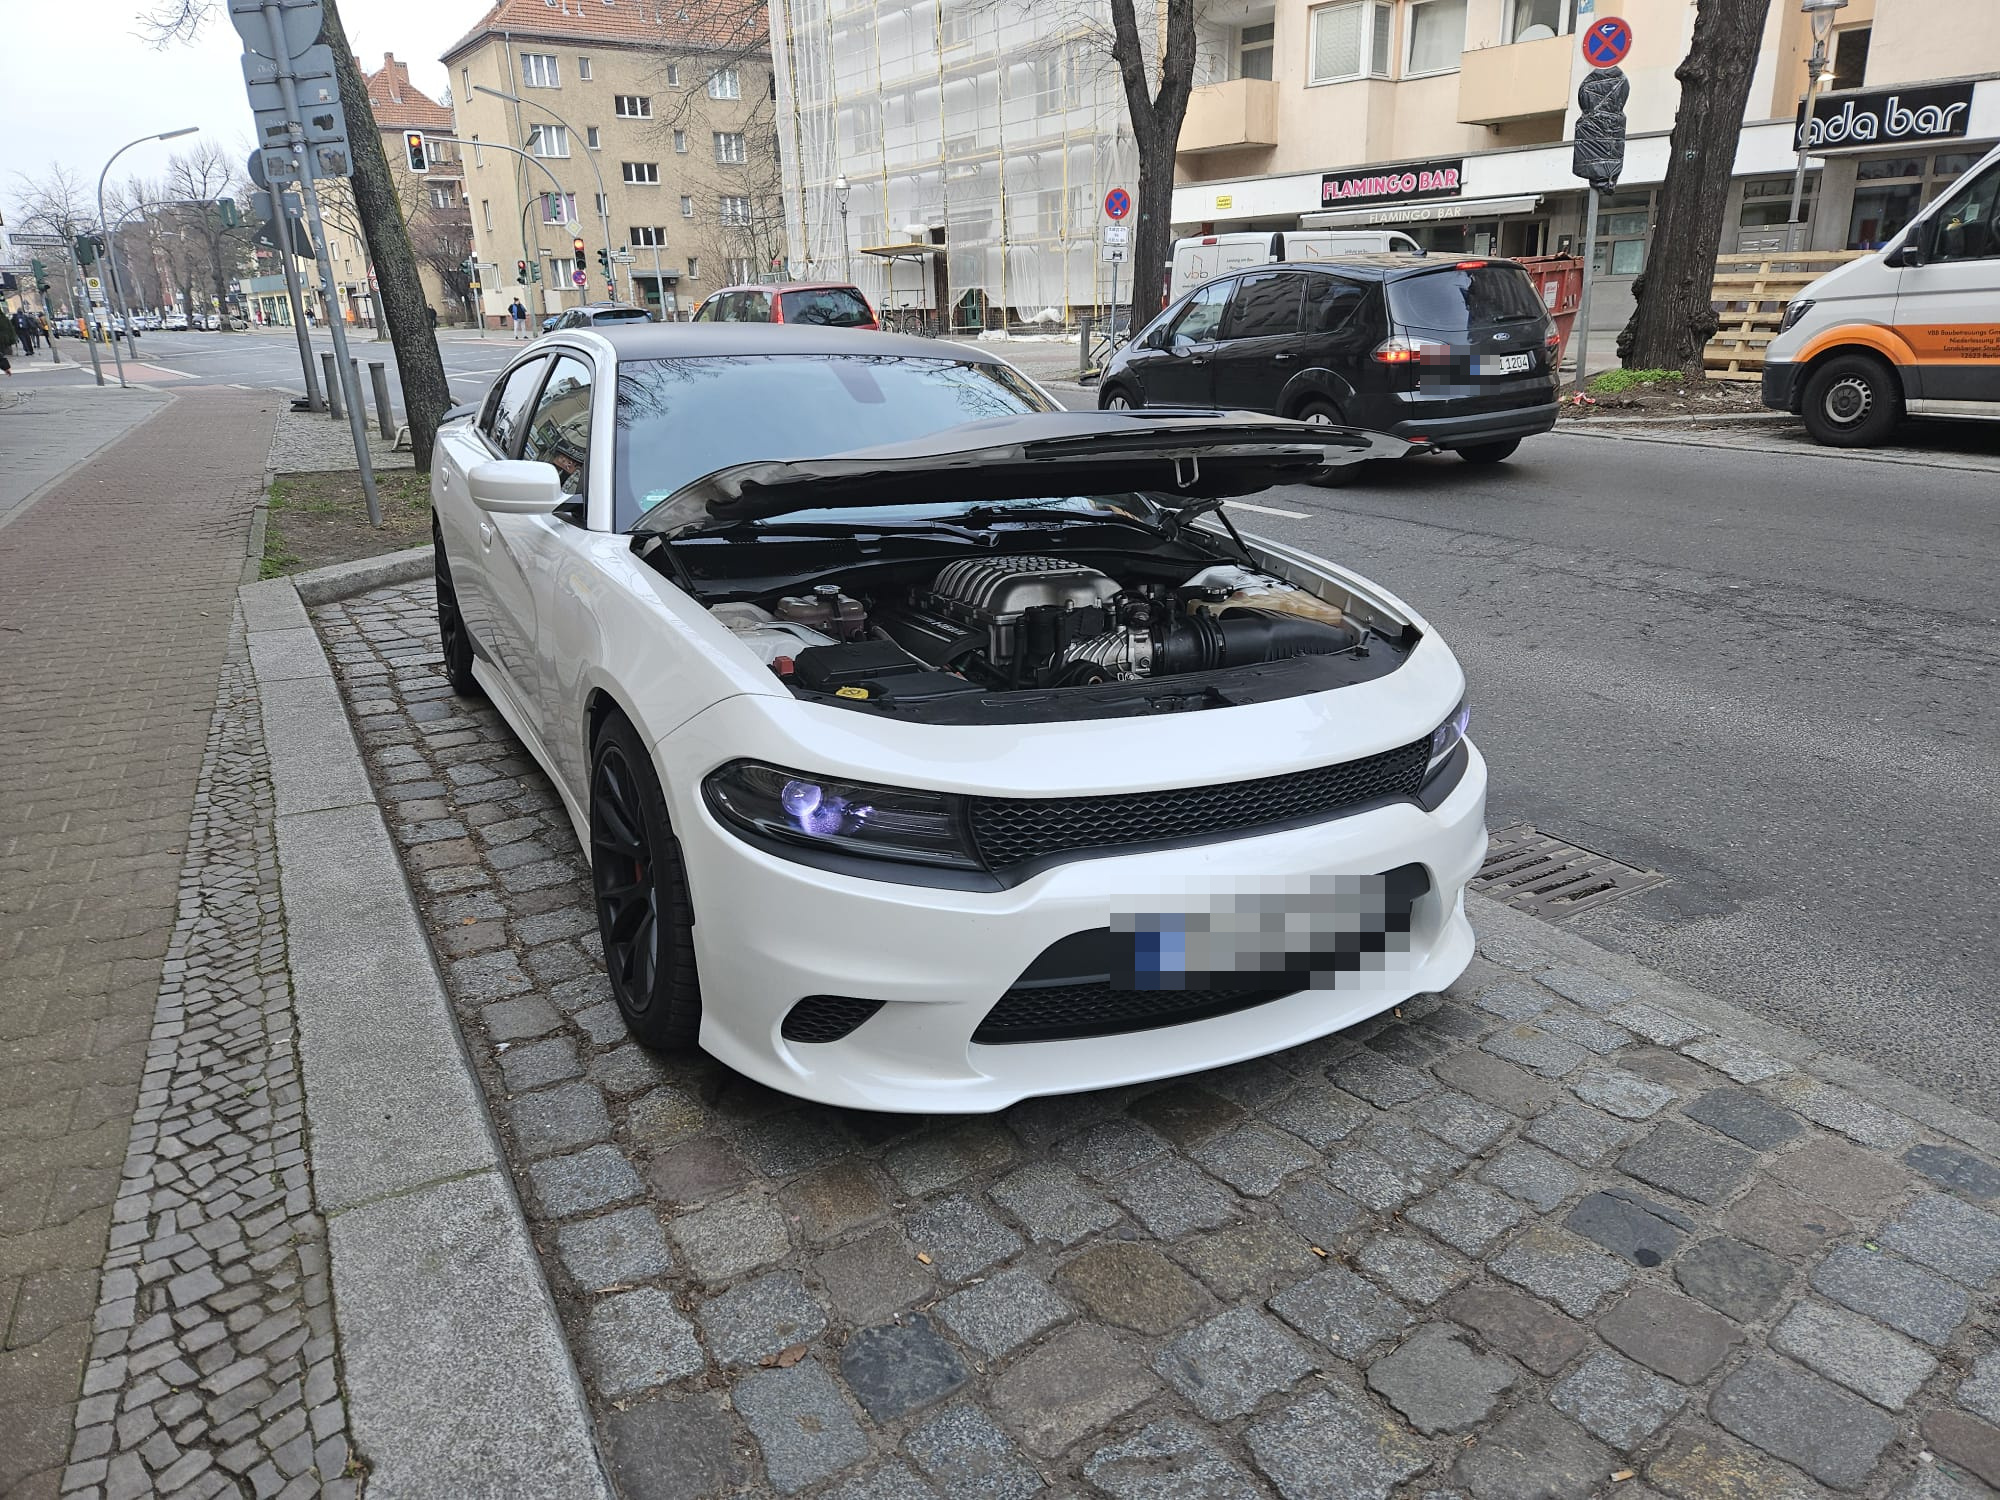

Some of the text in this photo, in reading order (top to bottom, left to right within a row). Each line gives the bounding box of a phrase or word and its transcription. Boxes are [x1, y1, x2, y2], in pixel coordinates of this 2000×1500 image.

[1798, 96, 1968, 144] ada bar
[1323, 168, 1459, 200] FLAMINGO BAR
[1369, 206, 1462, 224] FLAMINGO BAR
[1505, 356, 1527, 369] 1204
